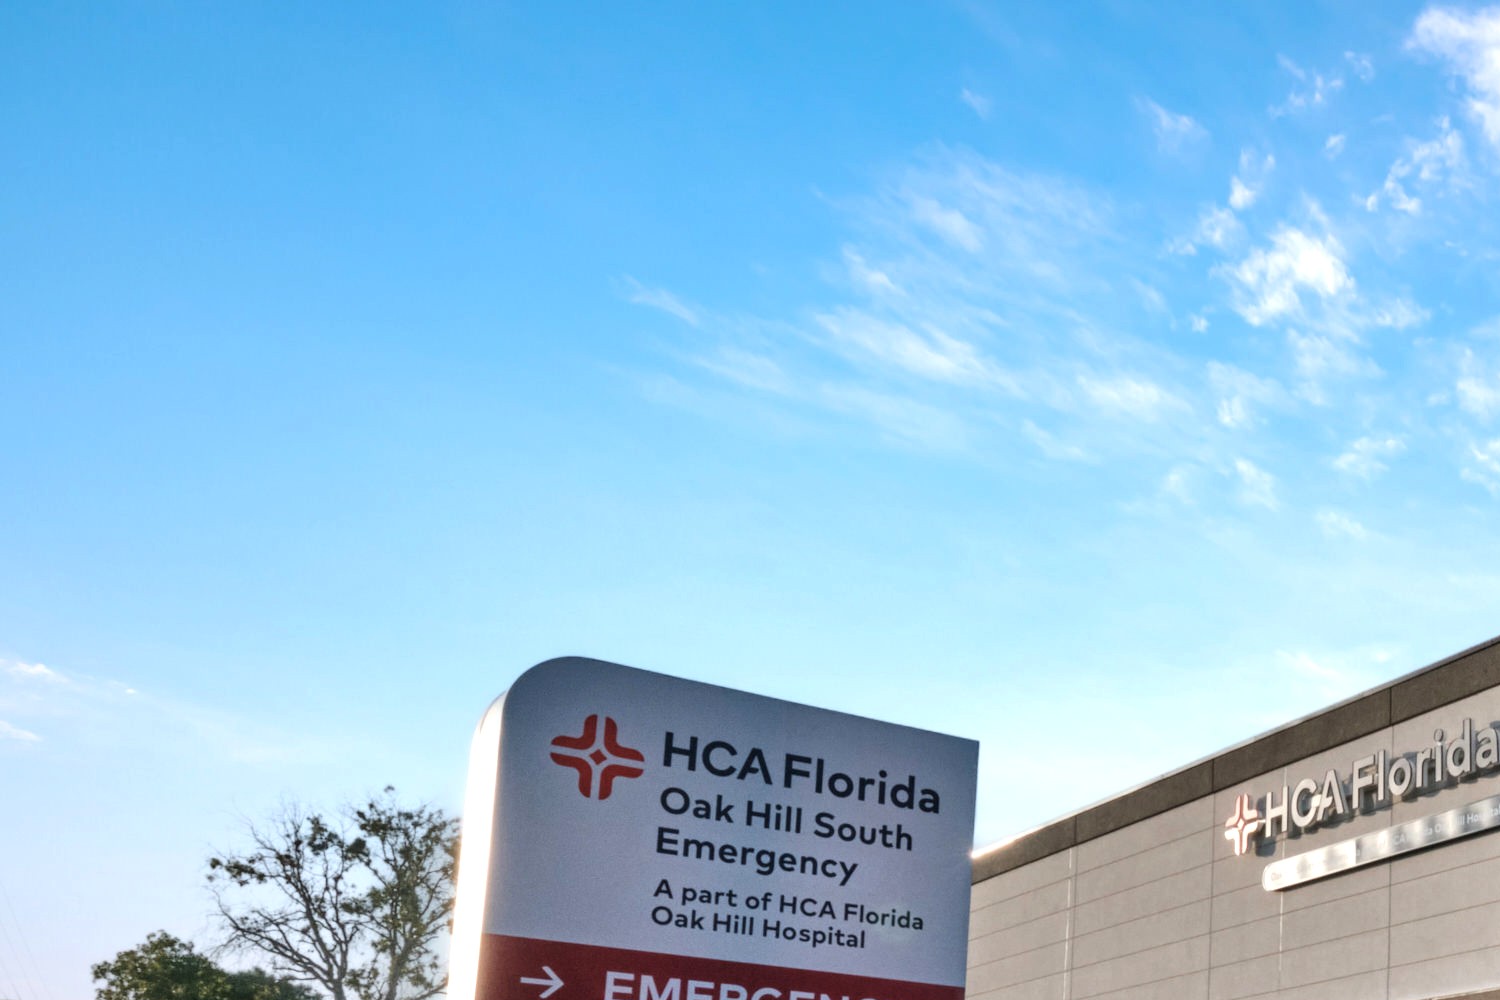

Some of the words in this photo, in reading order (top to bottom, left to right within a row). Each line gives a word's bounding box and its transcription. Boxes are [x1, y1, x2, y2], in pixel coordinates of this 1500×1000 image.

[663, 731, 774, 786] HCA
[783, 752, 941, 814] Florida
[1265, 769, 1345, 838] HCA
[659, 786, 735, 825] Oak
[745, 801, 802, 835] Hill
[813, 812, 914, 852] South
[656, 826, 859, 886] Emergency
[651, 906, 705, 931] Oak
[712, 912, 755, 936] Hill
[762, 919, 867, 950] Hospital
[653, 878, 674, 899] A
[681, 883, 738, 911] part
[745, 891, 773, 912] of
[779, 895, 836, 921] HCA
[843, 903, 925, 932] Florida
